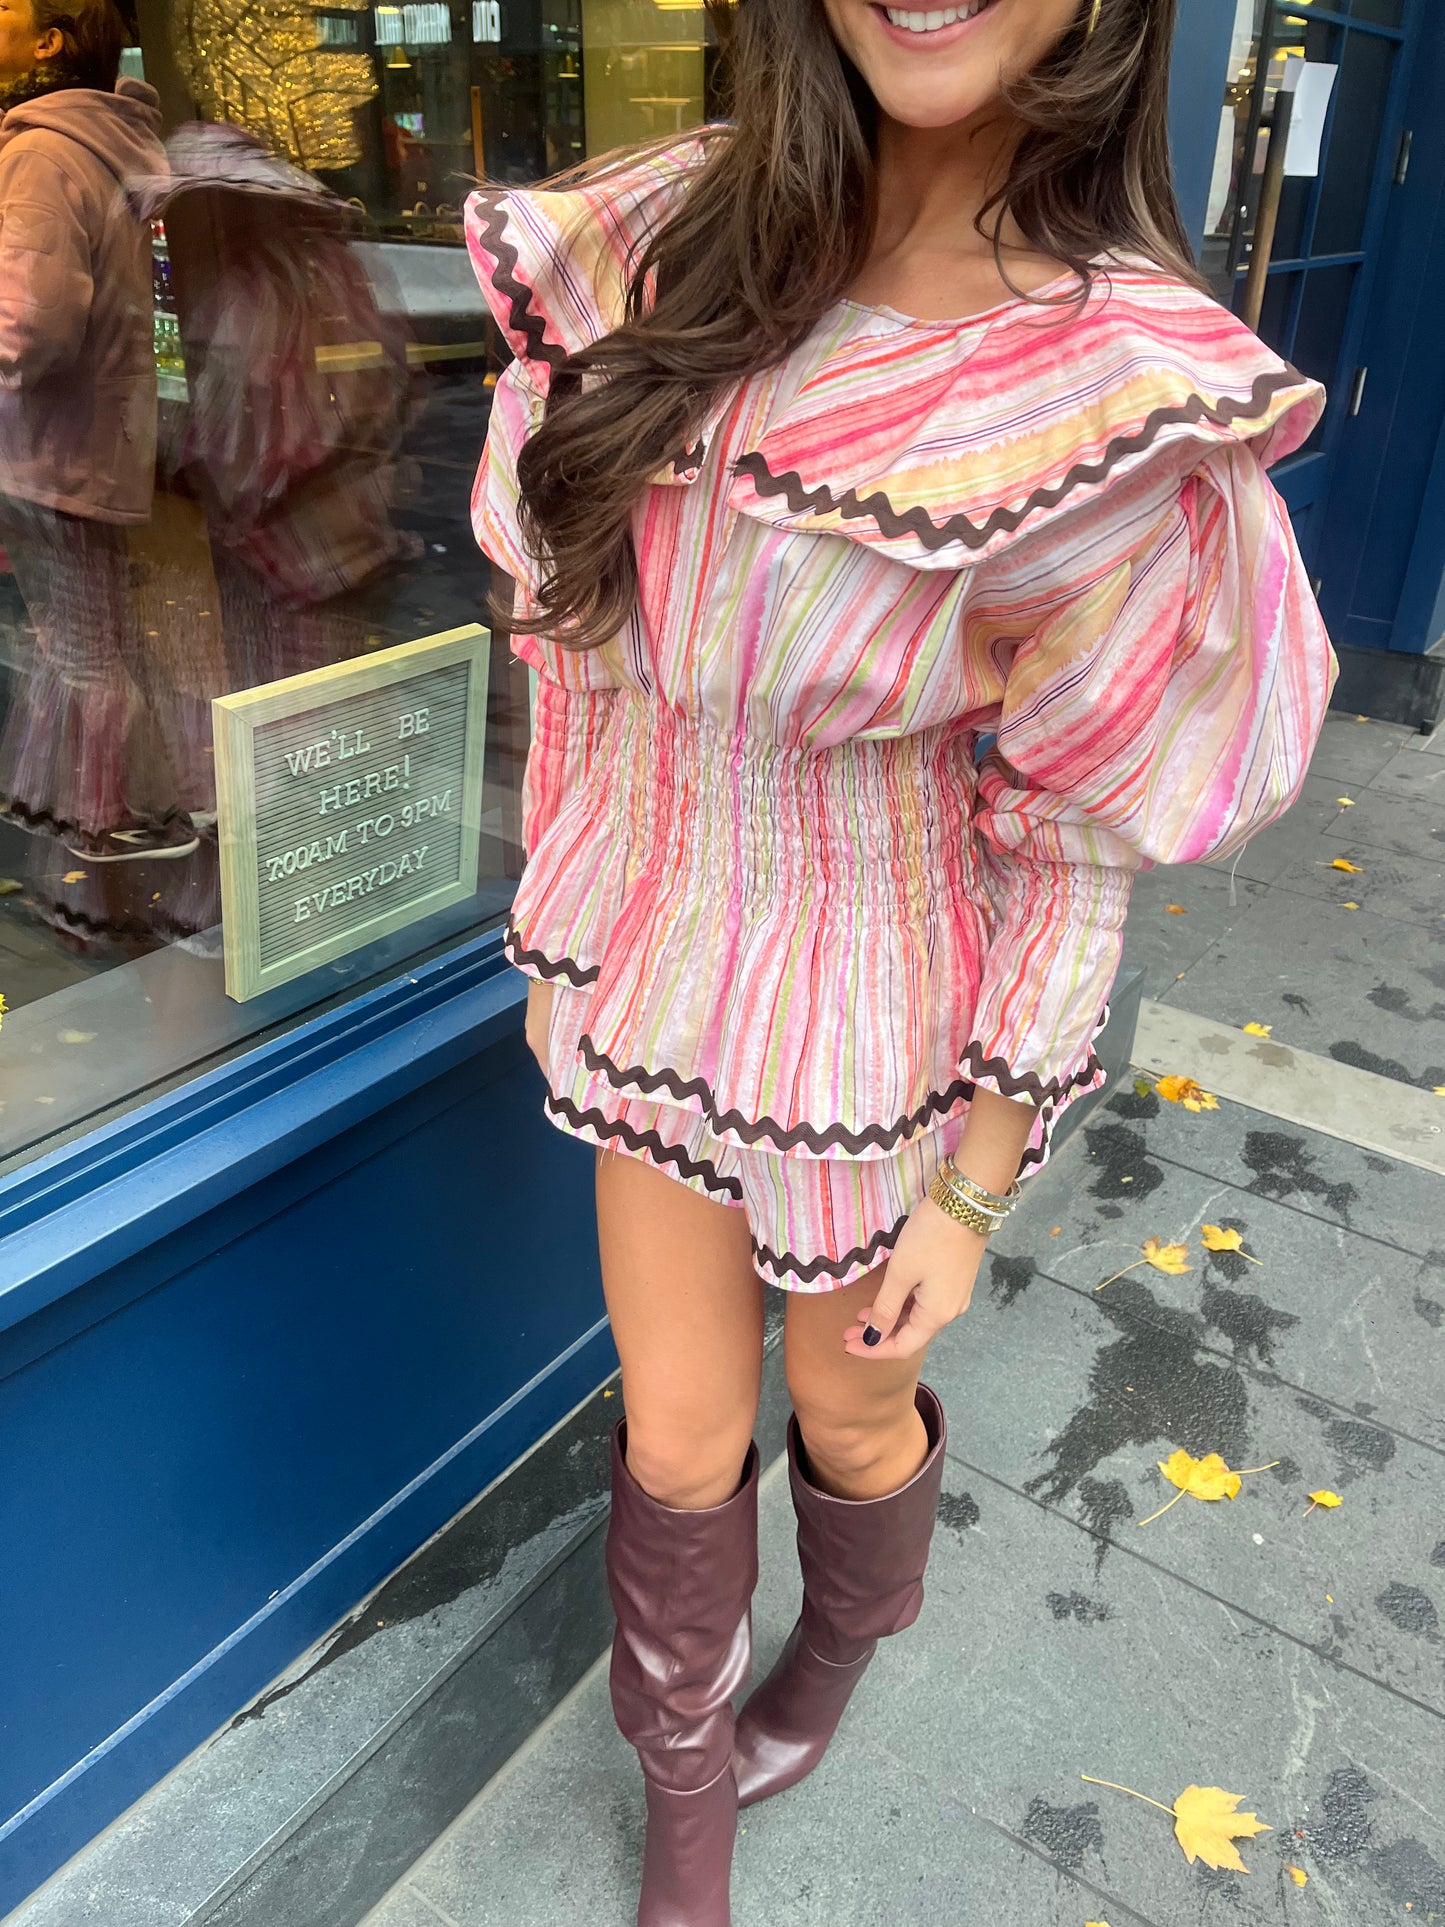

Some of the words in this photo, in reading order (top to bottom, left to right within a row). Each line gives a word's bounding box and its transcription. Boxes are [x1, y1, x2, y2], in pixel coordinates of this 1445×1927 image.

[284, 729, 370, 777] WE'LL
[398, 707, 429, 739] BE
[319, 754, 410, 815] HERE!
[356, 814, 394, 844] TO
[400, 789, 452, 828] 9PM
[294, 845, 429, 923] EVERYDAY
